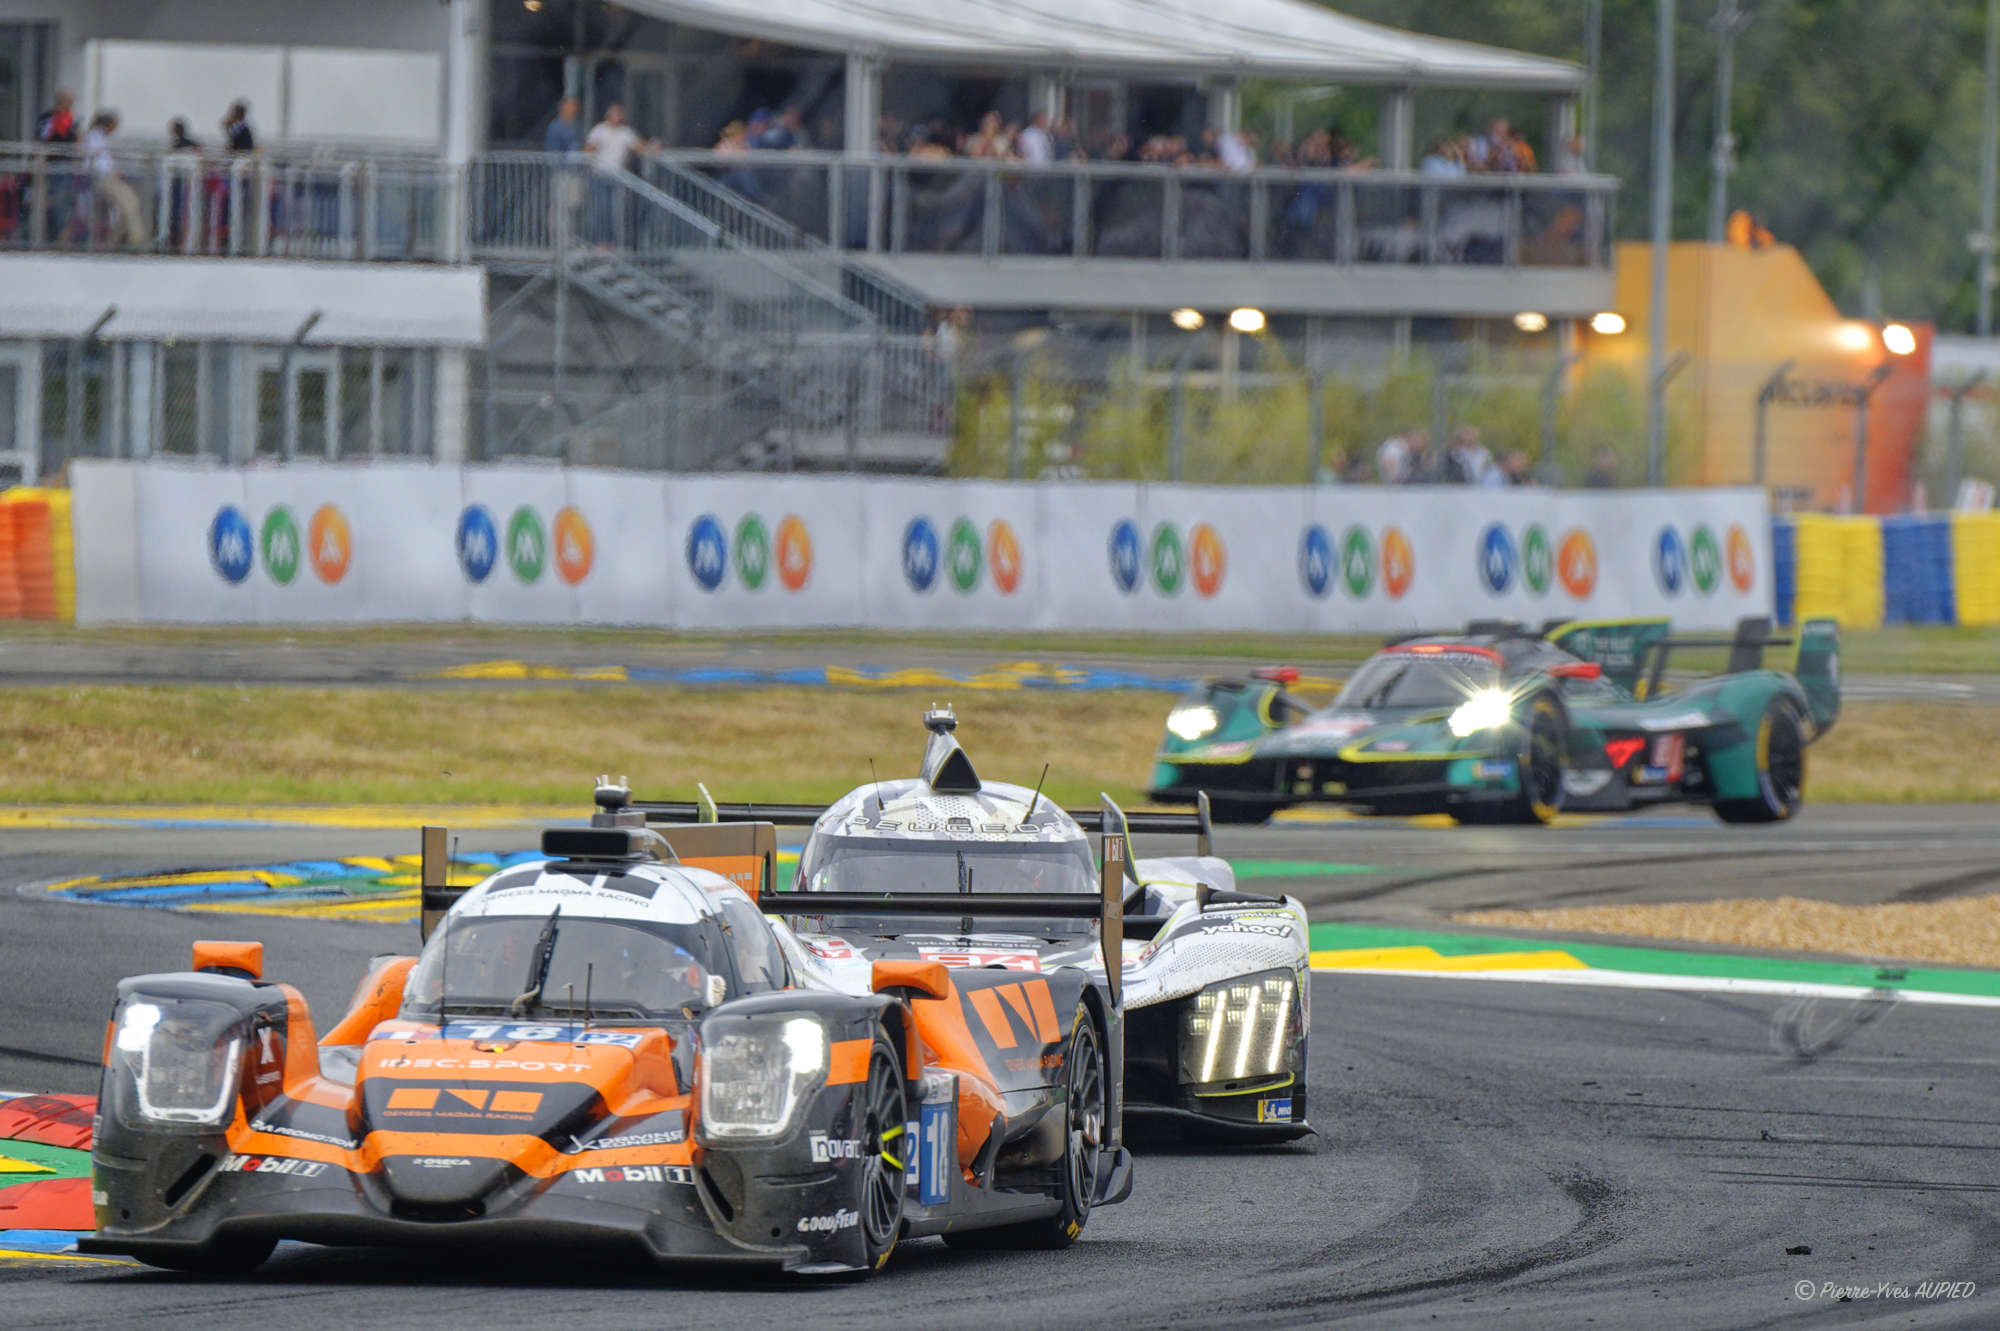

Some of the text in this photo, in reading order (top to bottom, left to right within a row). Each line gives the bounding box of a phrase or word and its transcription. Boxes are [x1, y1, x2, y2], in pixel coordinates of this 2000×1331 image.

[851, 815, 1060, 834] PEUGEOT
[596, 891, 649, 909] RACING
[1201, 921, 1294, 938] yahoo!
[579, 1033, 640, 1046] P2
[486, 1113, 534, 1121] RACING
[423, 1157, 472, 1166] ORECA
[926, 1111, 949, 1197] 18
[217, 1154, 299, 1175] Mobil
[574, 1165, 663, 1184] Mobil
